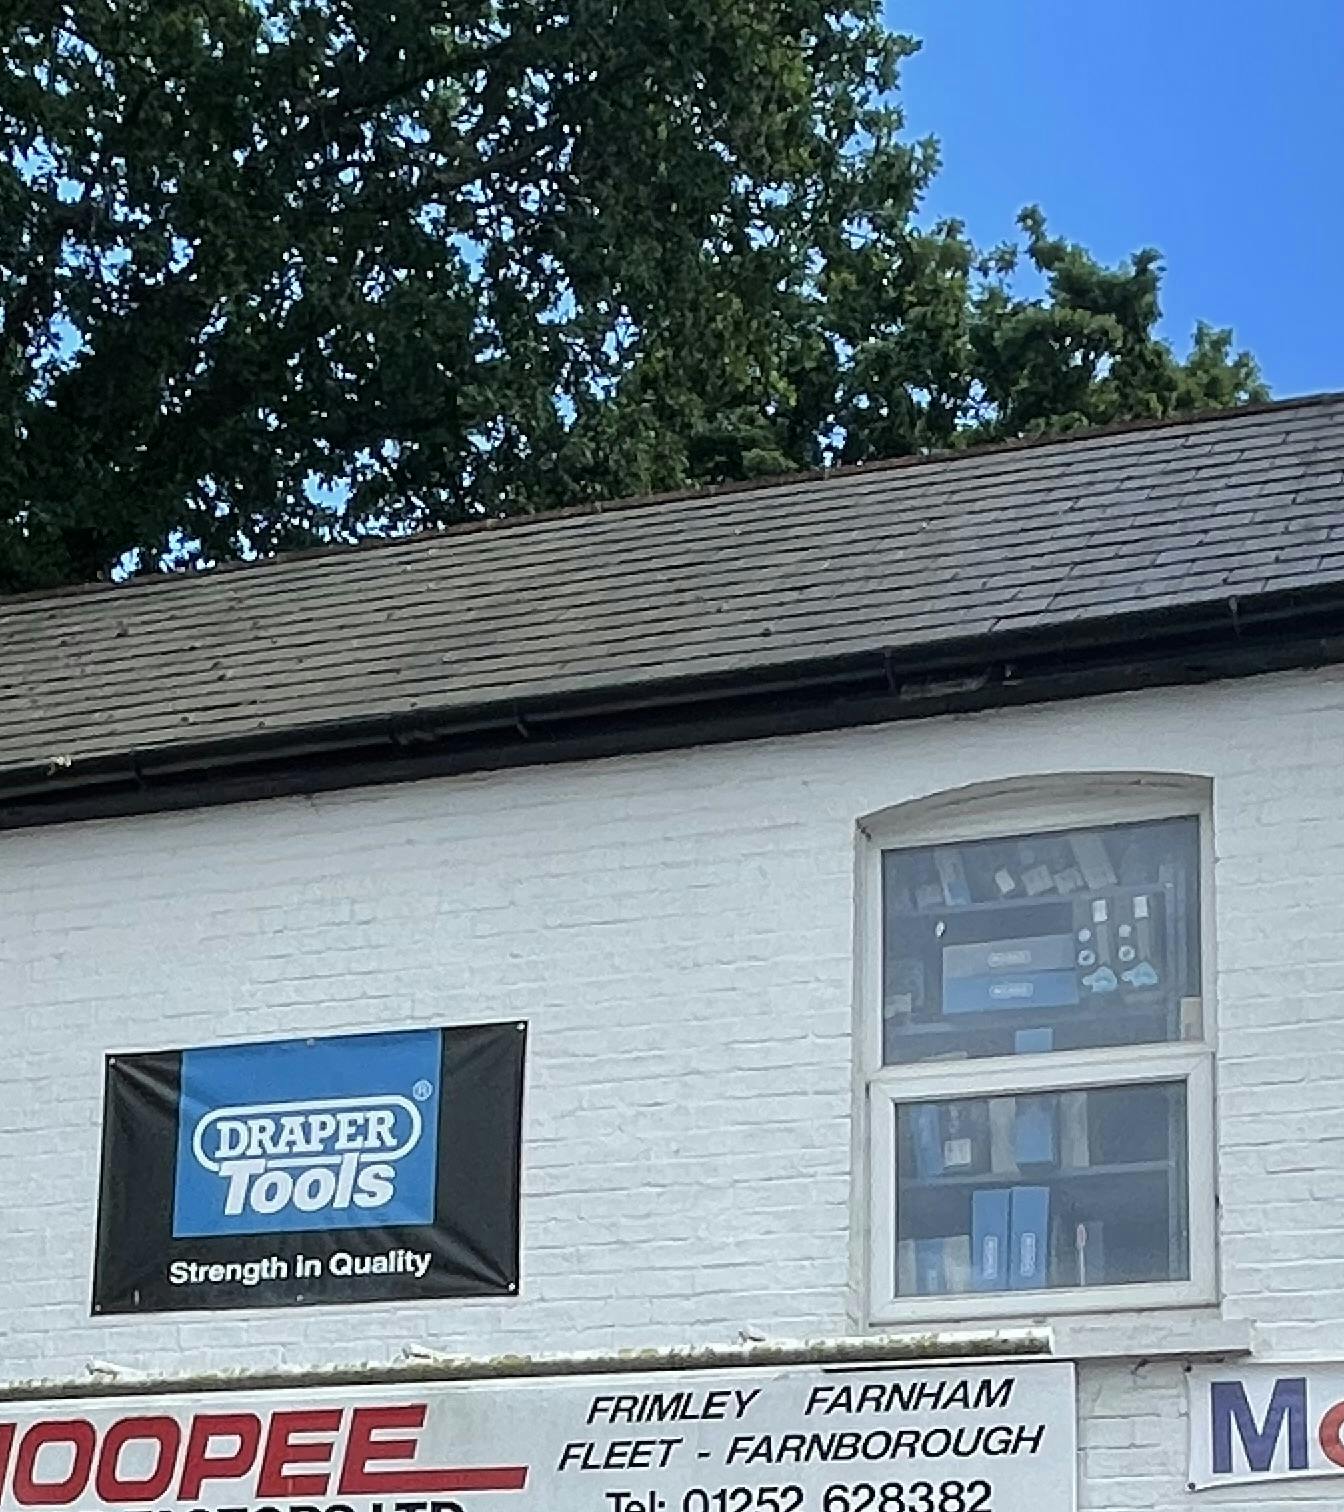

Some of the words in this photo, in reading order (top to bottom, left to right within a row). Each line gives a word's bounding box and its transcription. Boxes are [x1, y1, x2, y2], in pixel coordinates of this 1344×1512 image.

[215, 1110, 397, 1158] DRAPER
[217, 1152, 396, 1216] Tools
[169, 1258, 287, 1286] Strength
[295, 1255, 321, 1278] in
[329, 1249, 432, 1280] Quality
[586, 1389, 760, 1424] FRIMLEY
[804, 1378, 1014, 1415] FARNHAM
[557, 1438, 682, 1471] FLEET
[725, 1424, 1045, 1466] FARNBOROUGH
